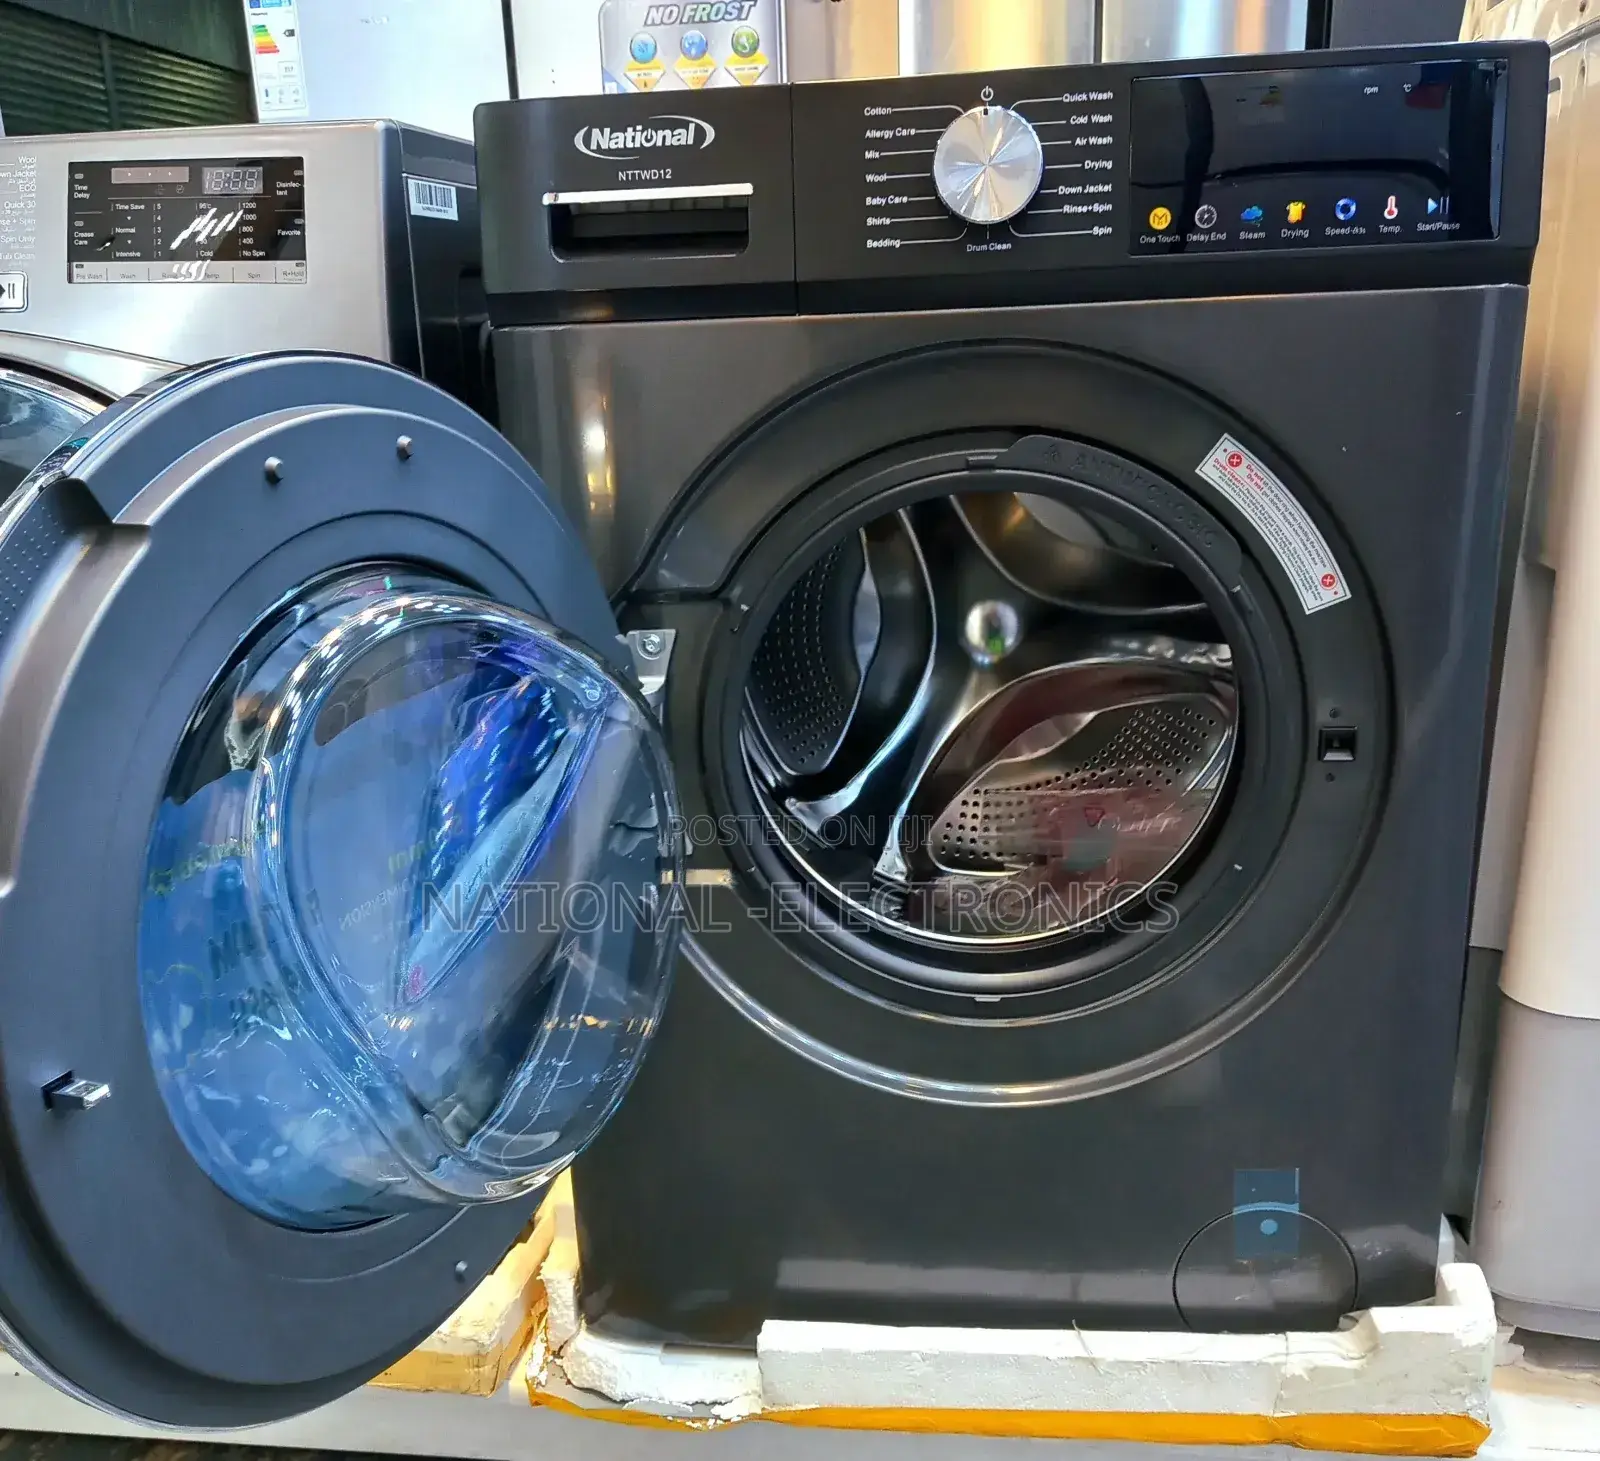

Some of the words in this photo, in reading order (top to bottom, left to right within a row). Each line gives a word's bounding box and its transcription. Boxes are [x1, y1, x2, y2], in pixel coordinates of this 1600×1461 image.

[644, 4, 680, 27] NO
[679, 0, 757, 25] FROST
[1363, 86, 1379, 95] rpm
[1063, 92, 1088, 103] Quick
[1089, 91, 1113, 101] Wash
[864, 106, 892, 117] Cotton
[1070, 115, 1088, 124] Cold
[1091, 114, 1113, 123] Wash
[590, 122, 696, 150] National
[865, 129, 894, 139] Allergy
[895, 127, 916, 136] Care
[1075, 137, 1087, 146] Air
[1089, 136, 1113, 145] Wash
[865, 150, 880, 159] Mix
[1084, 160, 1113, 171] Drying
[618, 169, 673, 181] NTTWD12
[865, 173, 887, 182] Wool
[19, 184, 36, 192] ECO
[1058, 186, 1082, 195] Down
[1083, 183, 1112, 194] Jacket
[4, 201, 25, 209] Quick
[26, 200, 36, 208] 30
[865, 197, 886, 206] Baby
[888, 195, 908, 204] Care
[1063, 203, 1112, 214] Rinse+Spin
[867, 217, 891, 226] Shirts
[1093, 226, 1112, 236] Spin
[1239, 231, 1266, 240] Steam
[1281, 228, 1309, 239] Drying
[0, 235, 17, 244] Spin
[1140, 235, 1156, 244] One
[1157, 234, 1181, 243] Touch
[1187, 233, 1209, 243] Delay
[1211, 232, 1227, 241] End
[867, 238, 901, 249] Bedding
[966, 243, 988, 252] Drum
[989, 242, 1012, 251] Clean
[252, 250, 265, 258] Spin
[1213, 457, 1228, 471] Drum
[1245, 463, 1255, 473] Do
[1253, 471, 1264, 481] not
[1245, 473, 1255, 482] Do
[1253, 480, 1264, 491] not
